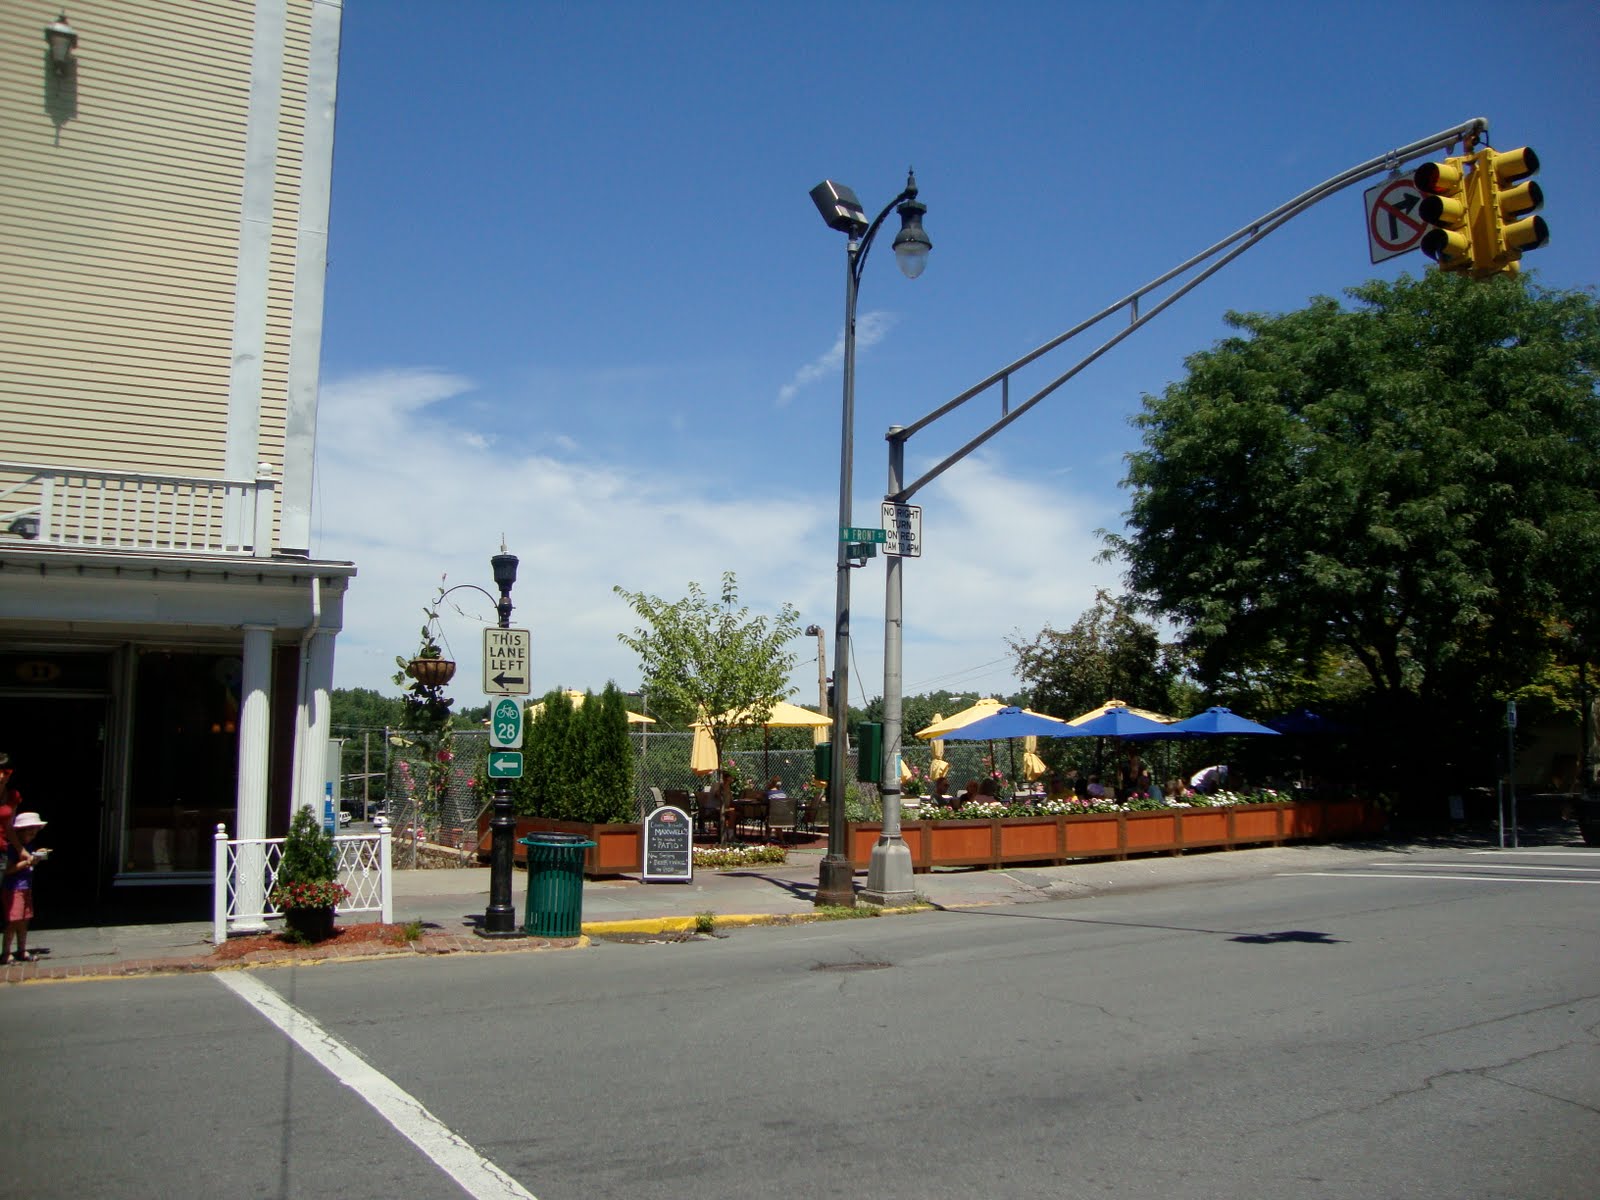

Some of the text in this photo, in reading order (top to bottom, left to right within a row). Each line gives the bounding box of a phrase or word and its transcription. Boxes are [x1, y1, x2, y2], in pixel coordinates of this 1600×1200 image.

[884, 507, 919, 519] NO RIGHT
[891, 519, 911, 530] TURN
[852, 530, 876, 541] FRONT
[887, 530, 916, 541] ON RED
[898, 542, 905, 551] TO
[492, 633, 522, 646] THIS
[489, 646, 526, 659] LANE
[491, 659, 525, 671] LEFT
[498, 723, 516, 739] 28
